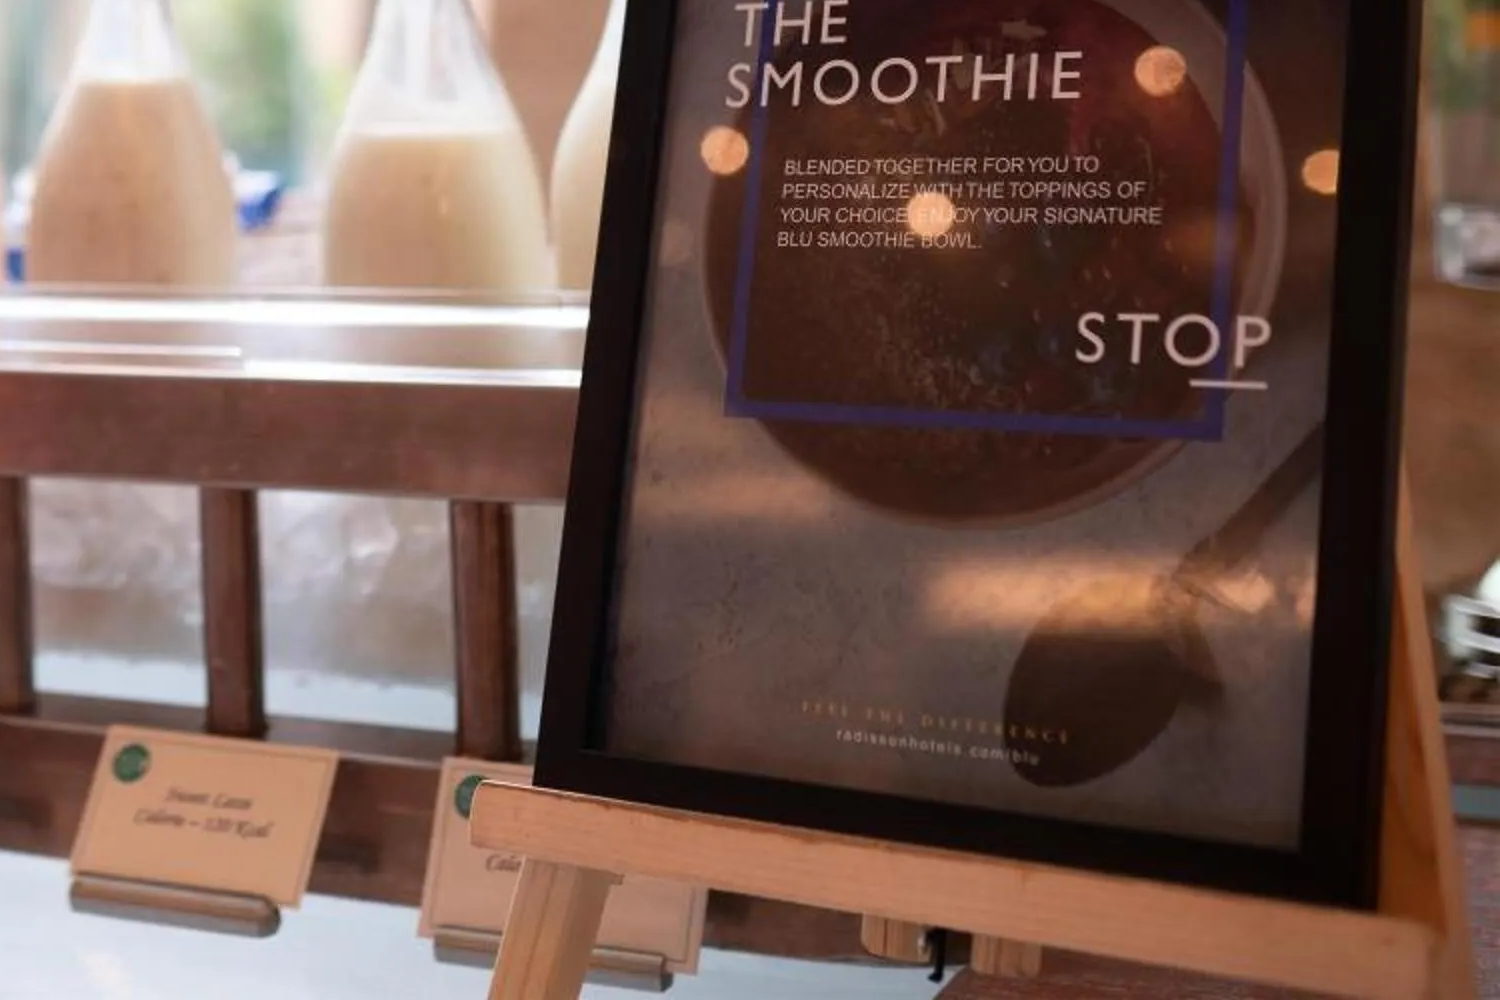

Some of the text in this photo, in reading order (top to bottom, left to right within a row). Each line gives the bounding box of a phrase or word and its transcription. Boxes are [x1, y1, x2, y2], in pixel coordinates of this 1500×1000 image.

[725, 50, 1084, 108] SMOOTHIE
[784, 154, 1100, 176] BLENDED TOGETHER FOR YOU TO
[781, 180, 1148, 200] PERSONALIZE WITH THE TOPPINGS OF
[780, 207, 831, 224] YOUR
[983, 206, 1038, 224] YOUR
[1043, 206, 1164, 225] SIGNATURE
[777, 231, 813, 248] BLU
[817, 231, 915, 248] SMOOTHIE
[1075, 311, 1272, 369] STOP
